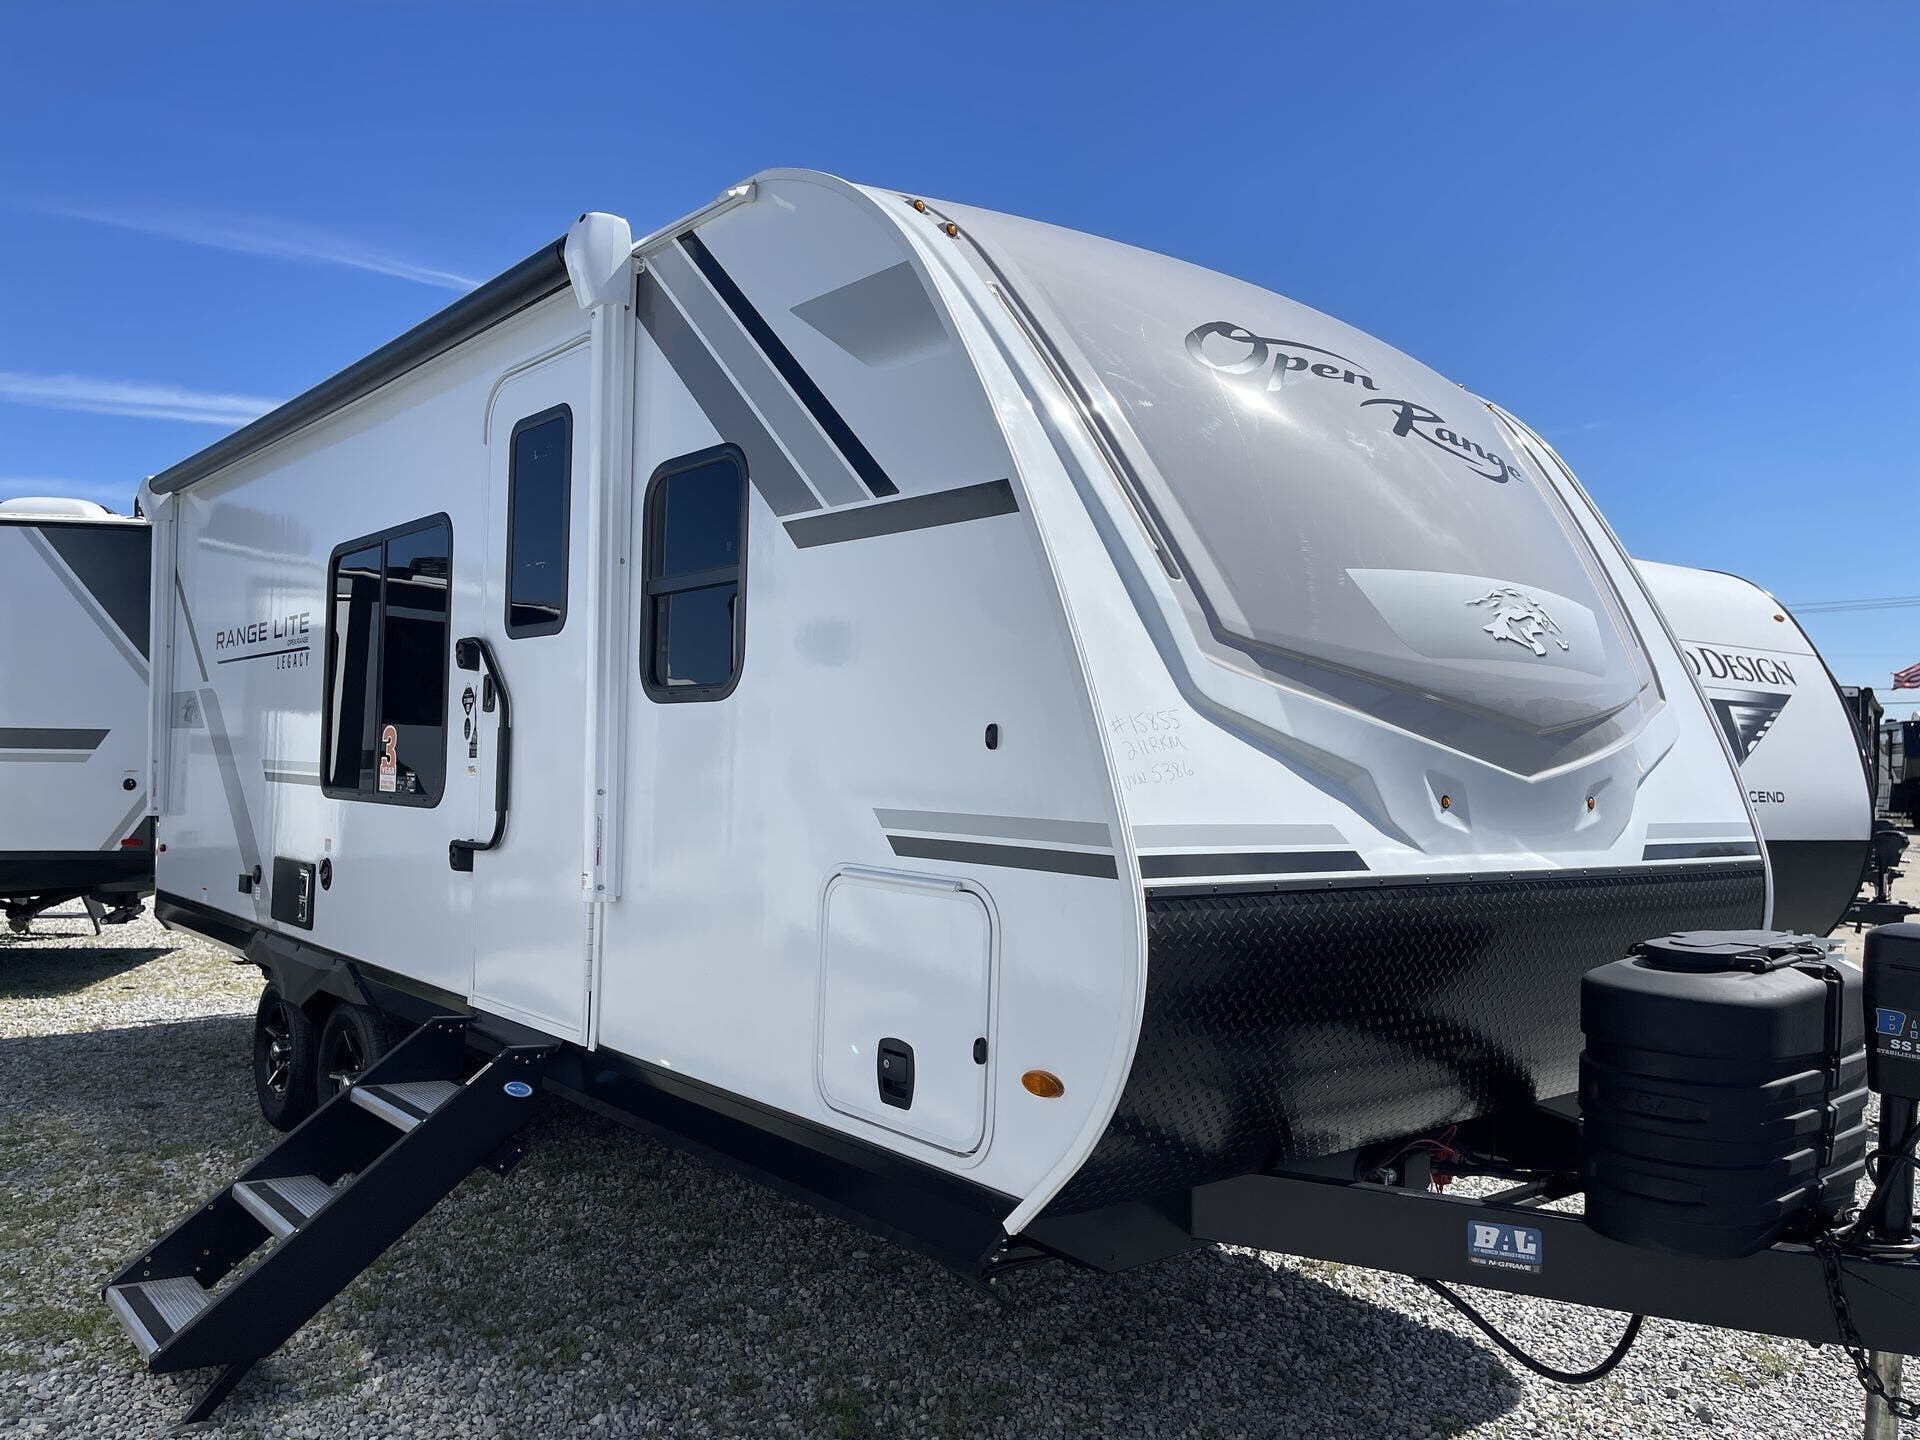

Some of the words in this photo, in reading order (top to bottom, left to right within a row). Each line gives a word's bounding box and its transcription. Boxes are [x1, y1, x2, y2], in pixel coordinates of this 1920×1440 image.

[1185, 320, 1380, 391] Open
[1360, 398, 1524, 483] Range
[215, 621, 267, 650] RANGE
[274, 612, 310, 638] LITE
[277, 652, 310, 669] LEGACY
[1111, 709, 1181, 735] #15855
[381, 724, 398, 766] 3
[381, 766, 395, 775] YEAR
[1890, 1039, 1912, 1051] SS
